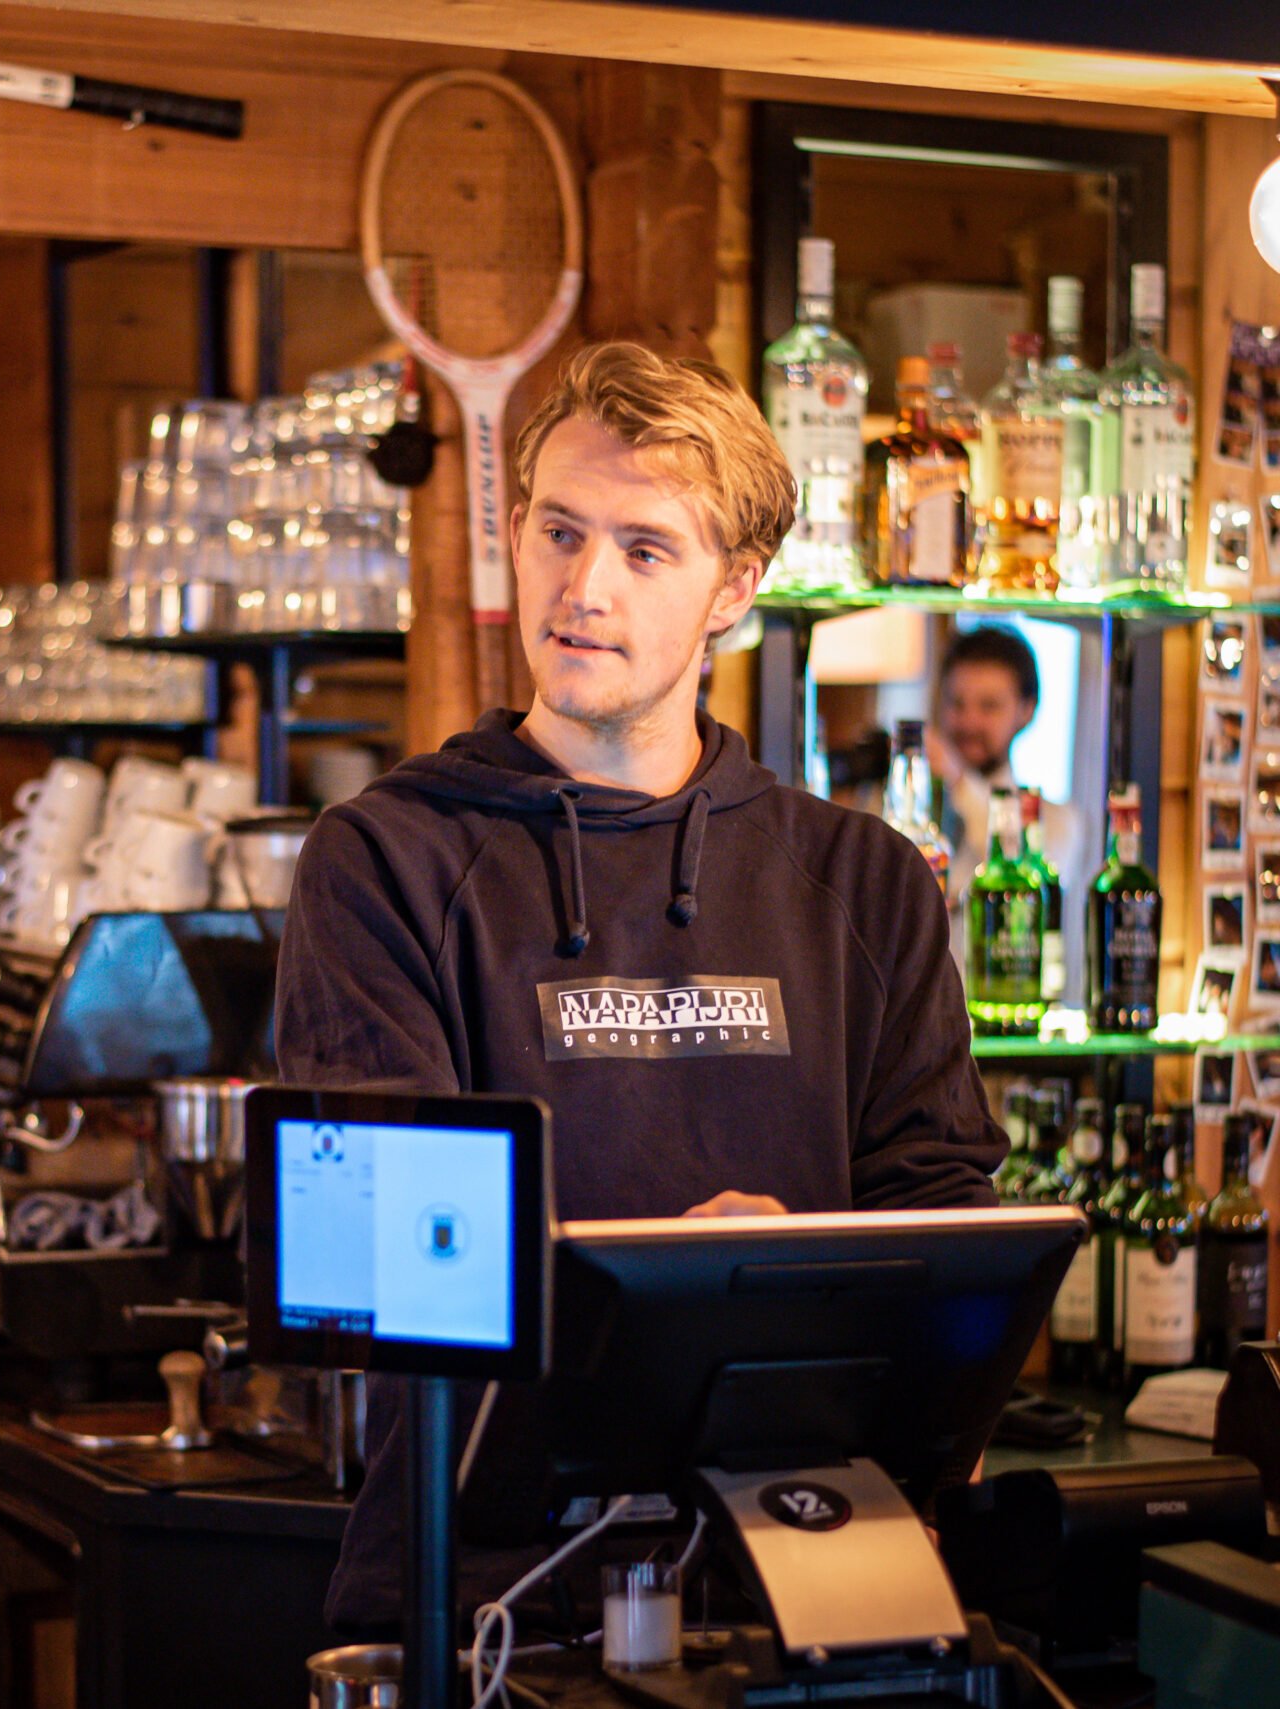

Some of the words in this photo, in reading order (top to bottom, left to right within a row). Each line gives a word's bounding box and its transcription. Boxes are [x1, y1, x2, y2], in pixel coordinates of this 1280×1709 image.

[478, 414, 498, 537] DUNLOP
[562, 989, 769, 1027] NAPAPIJRI
[563, 1028, 771, 1048] geographic
[1146, 1501, 1188, 1515] EPSON
